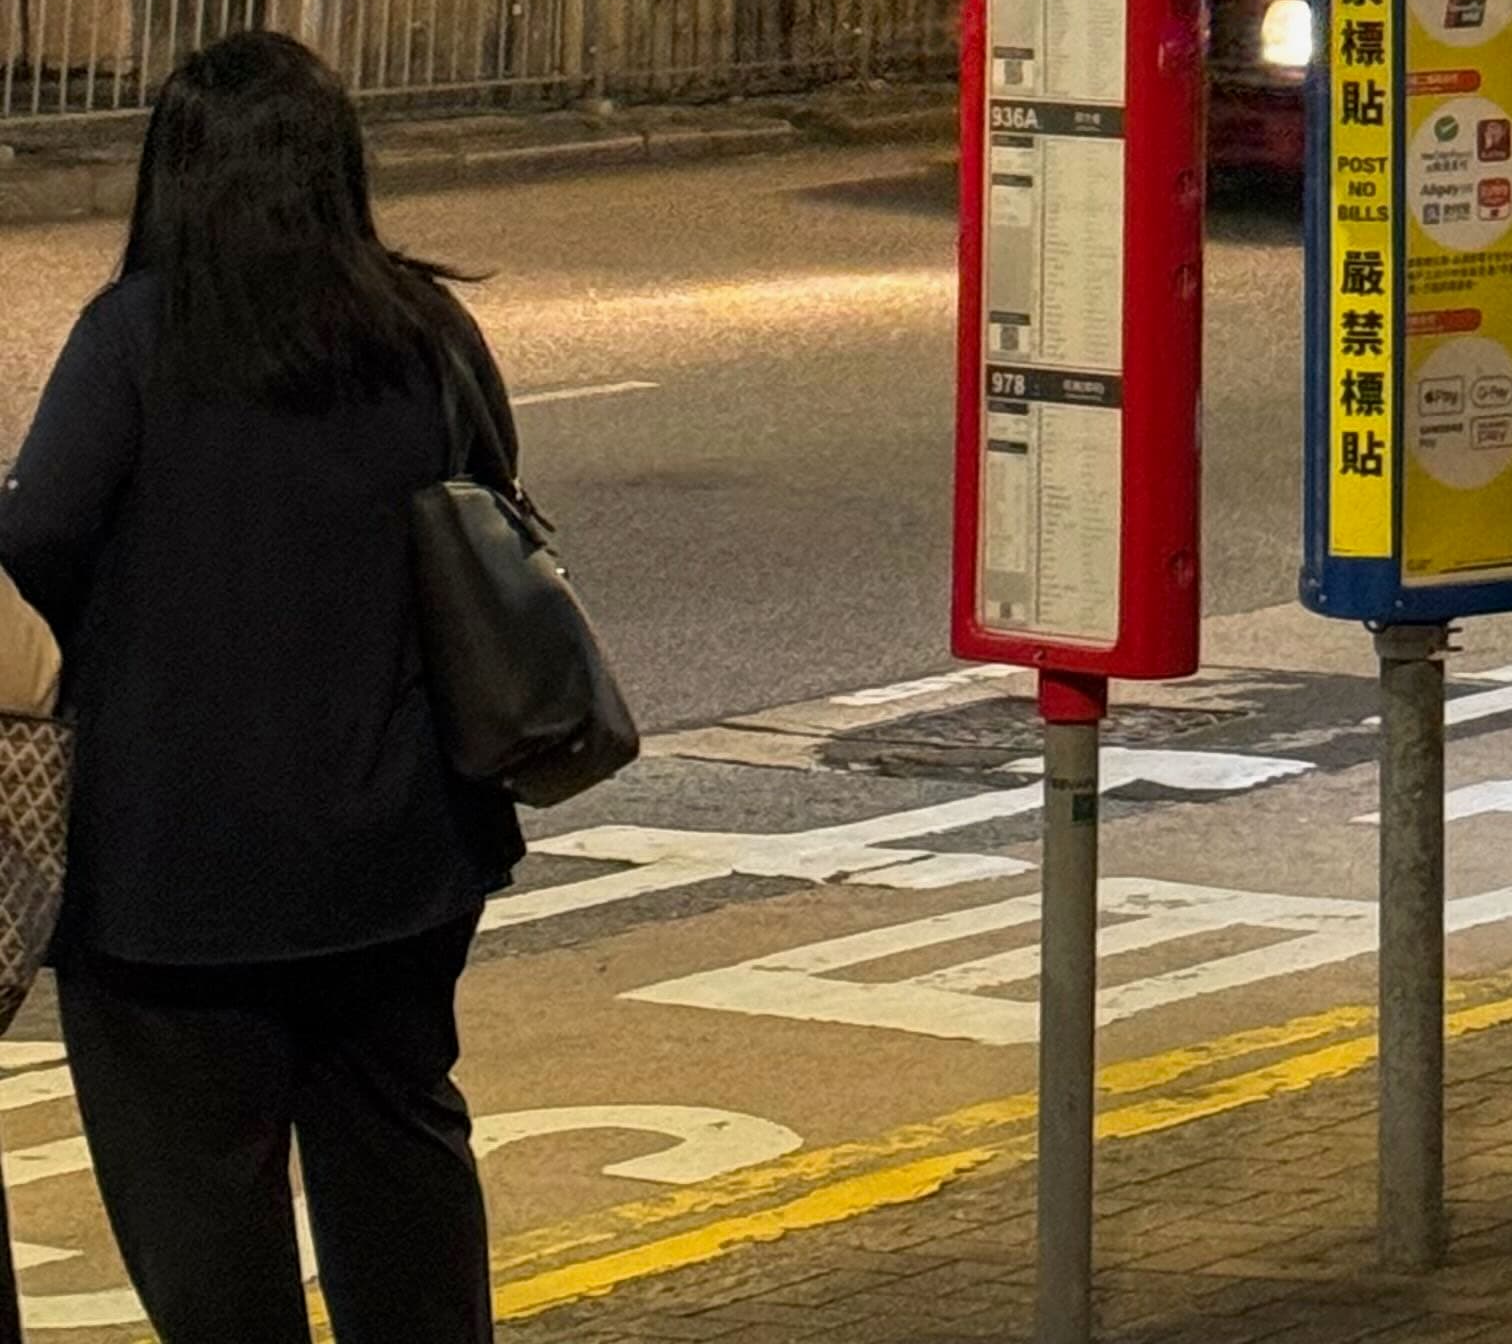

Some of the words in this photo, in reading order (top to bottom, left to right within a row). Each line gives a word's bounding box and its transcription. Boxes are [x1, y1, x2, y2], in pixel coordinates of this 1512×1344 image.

[992, 106, 1038, 130] 936A
[1337, 157, 1389, 175] POST
[1348, 181, 1377, 198] NO
[1337, 205, 1390, 223] BILLS
[1340, 250, 1385, 478] 嚴禁標貼
[991, 372, 1025, 396] 978
